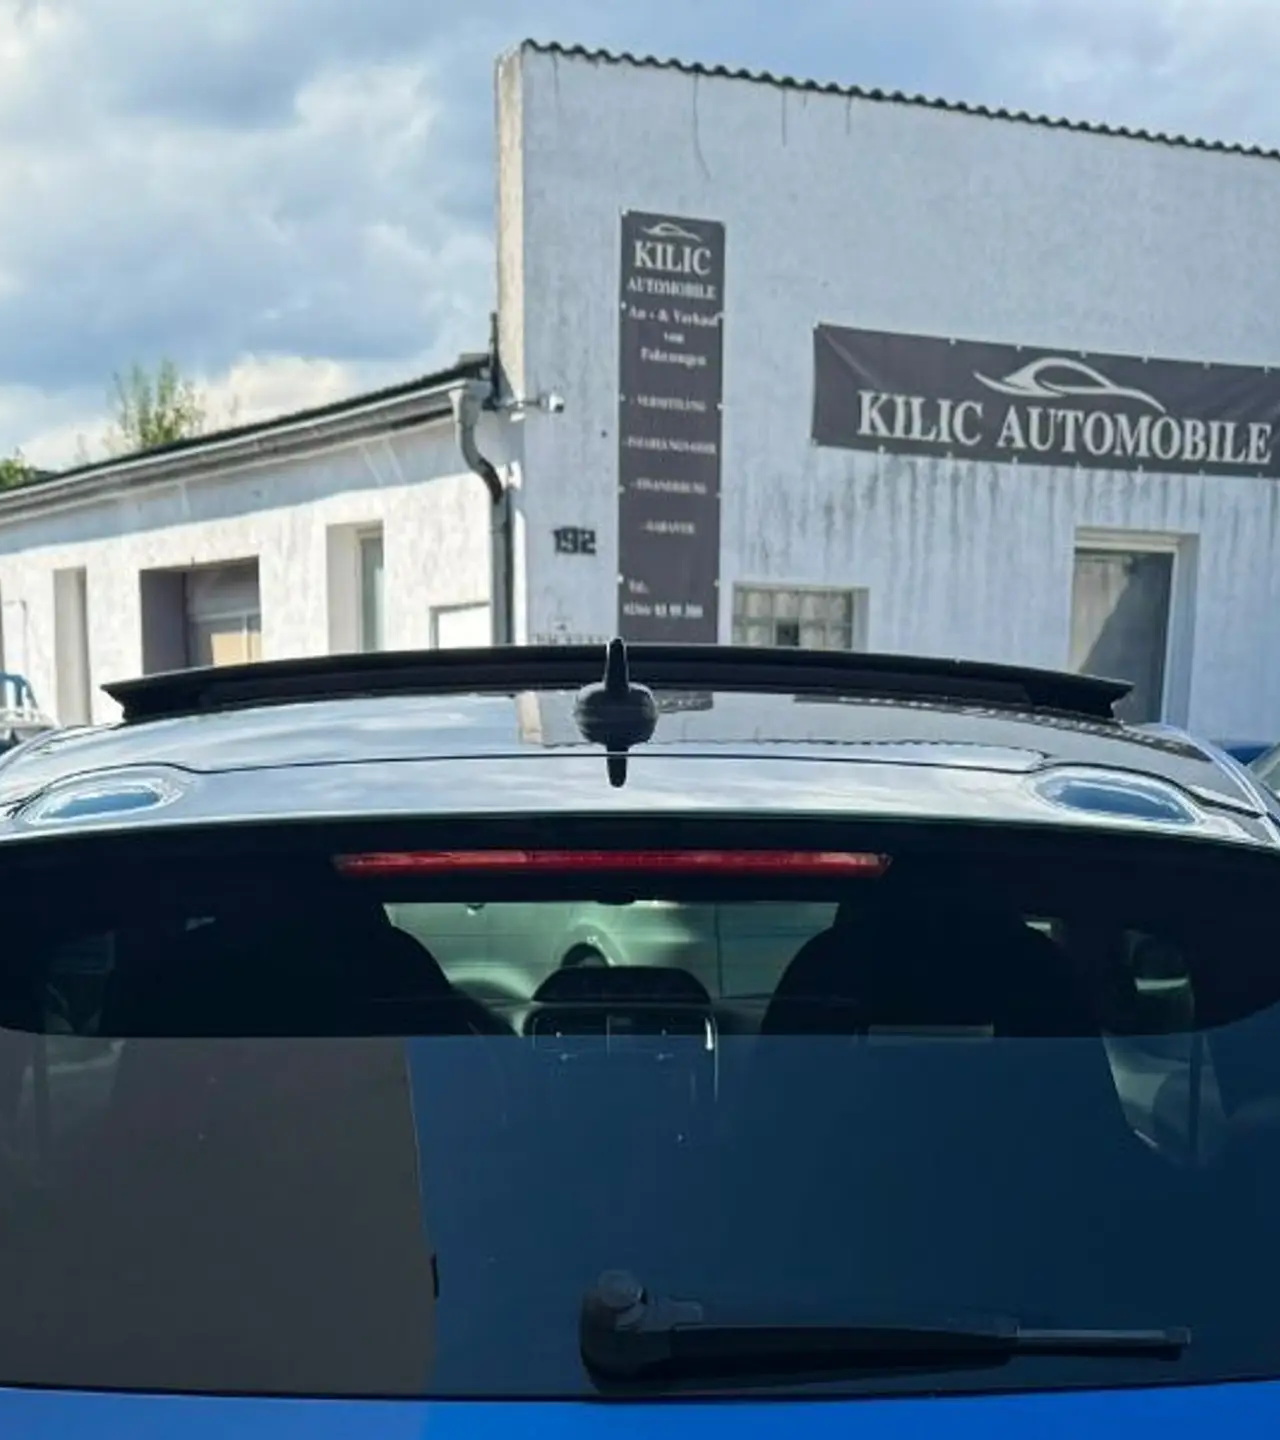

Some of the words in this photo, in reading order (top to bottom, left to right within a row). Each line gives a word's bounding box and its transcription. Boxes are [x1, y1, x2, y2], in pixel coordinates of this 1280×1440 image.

[634, 240, 711, 275] KILIC
[627, 276, 716, 299] AUTOMOBILE
[857, 390, 982, 447] KILIC
[996, 404, 1272, 465] AUTOMOBILE
